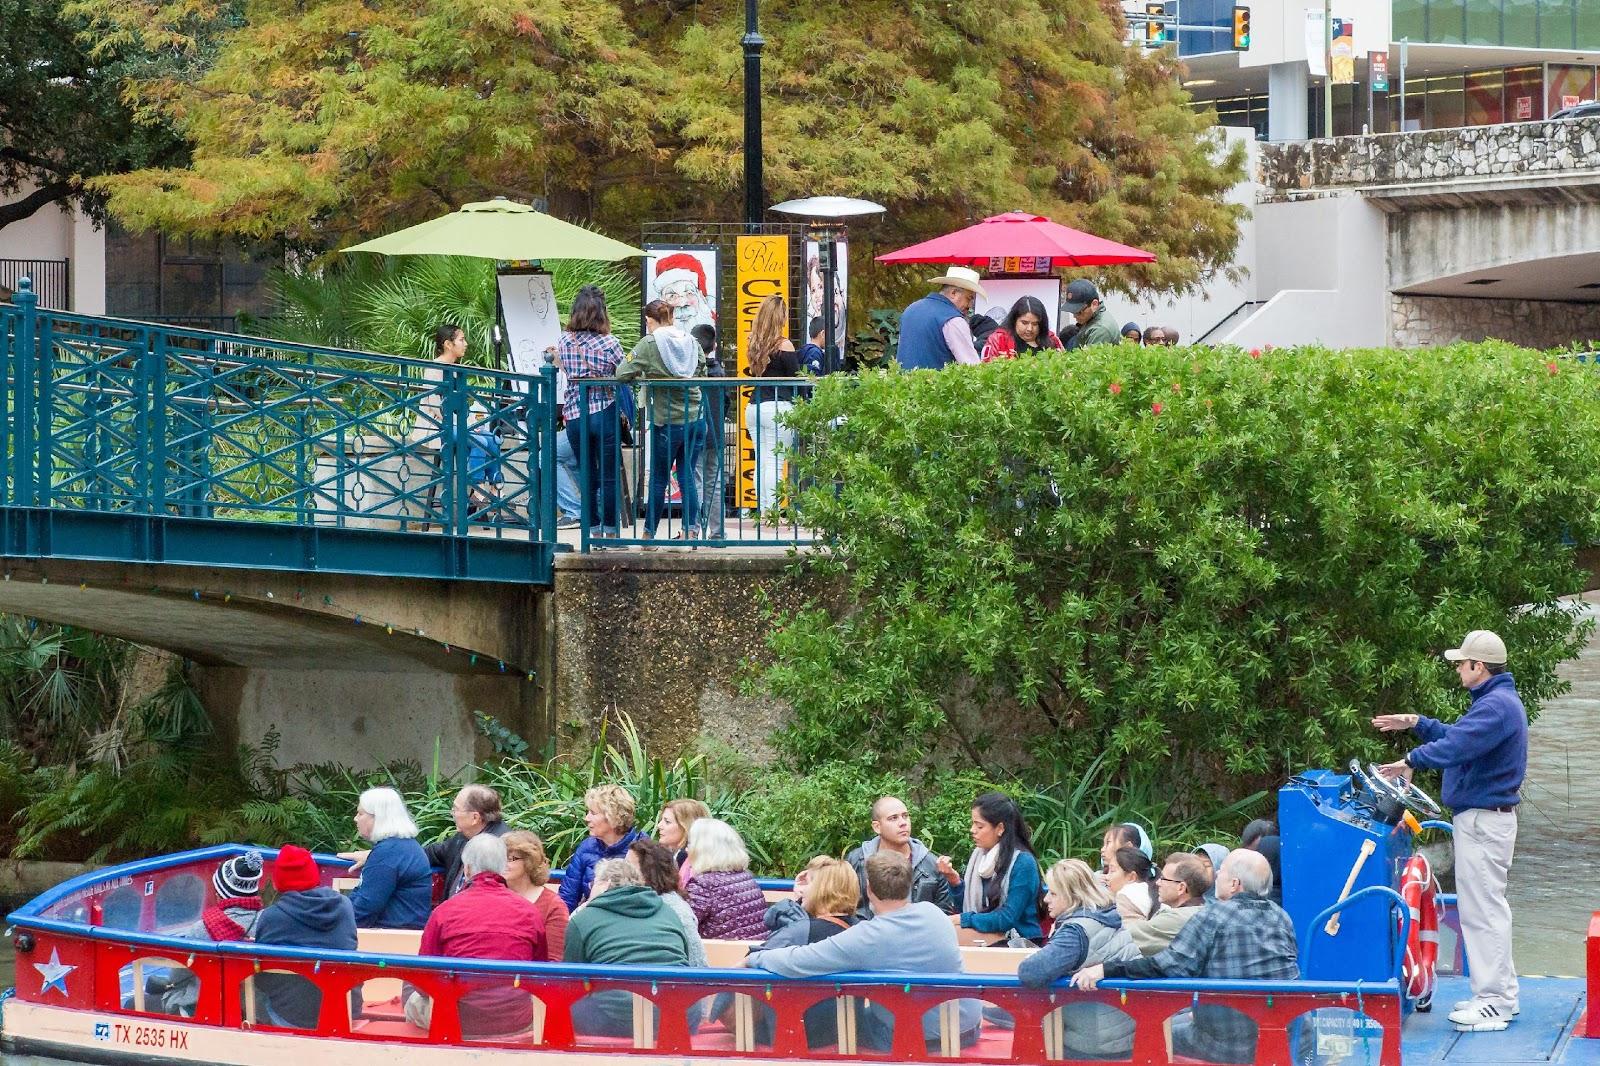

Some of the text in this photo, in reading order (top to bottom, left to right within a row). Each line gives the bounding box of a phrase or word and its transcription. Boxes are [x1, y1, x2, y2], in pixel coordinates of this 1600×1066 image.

[738, 240, 784, 272] Blas
[114, 1024, 188, 1050] TX 2535 HX
